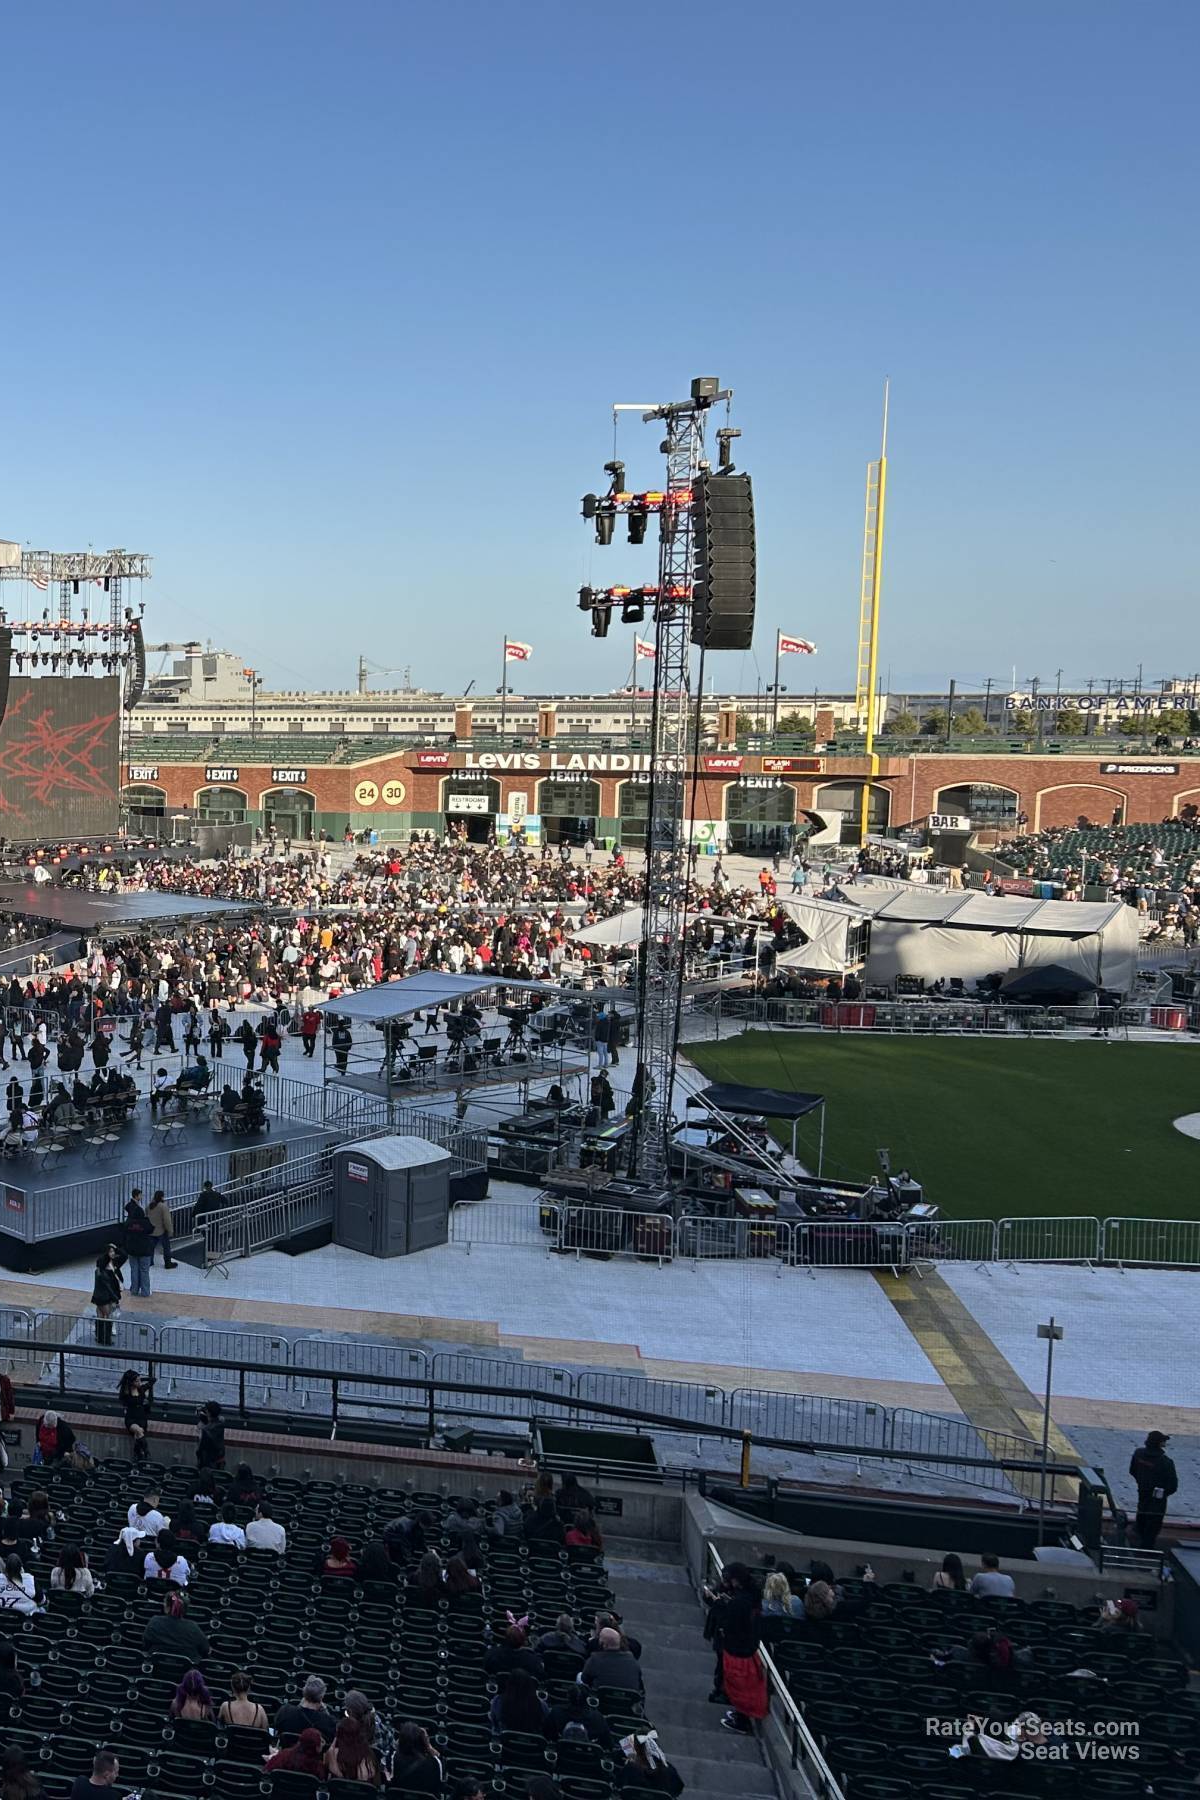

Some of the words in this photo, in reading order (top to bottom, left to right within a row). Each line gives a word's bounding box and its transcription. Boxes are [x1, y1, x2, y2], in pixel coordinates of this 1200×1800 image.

[1004, 696, 1068, 711] BANK
[1078, 696, 1108, 711] OF
[133, 770, 152, 780] EXIT
[211, 770, 231, 781] EXIT
[459, 770, 482, 780] EXIT
[1118, 766, 1175, 774] PRIZEPICKS
[278, 771, 298, 782] EXIT
[557, 772, 581, 782] EXIT
[747, 778, 774, 789] EXIT
[359, 788, 375, 799] 24
[386, 787, 401, 798] 30
[931, 816, 959, 828] BAR
